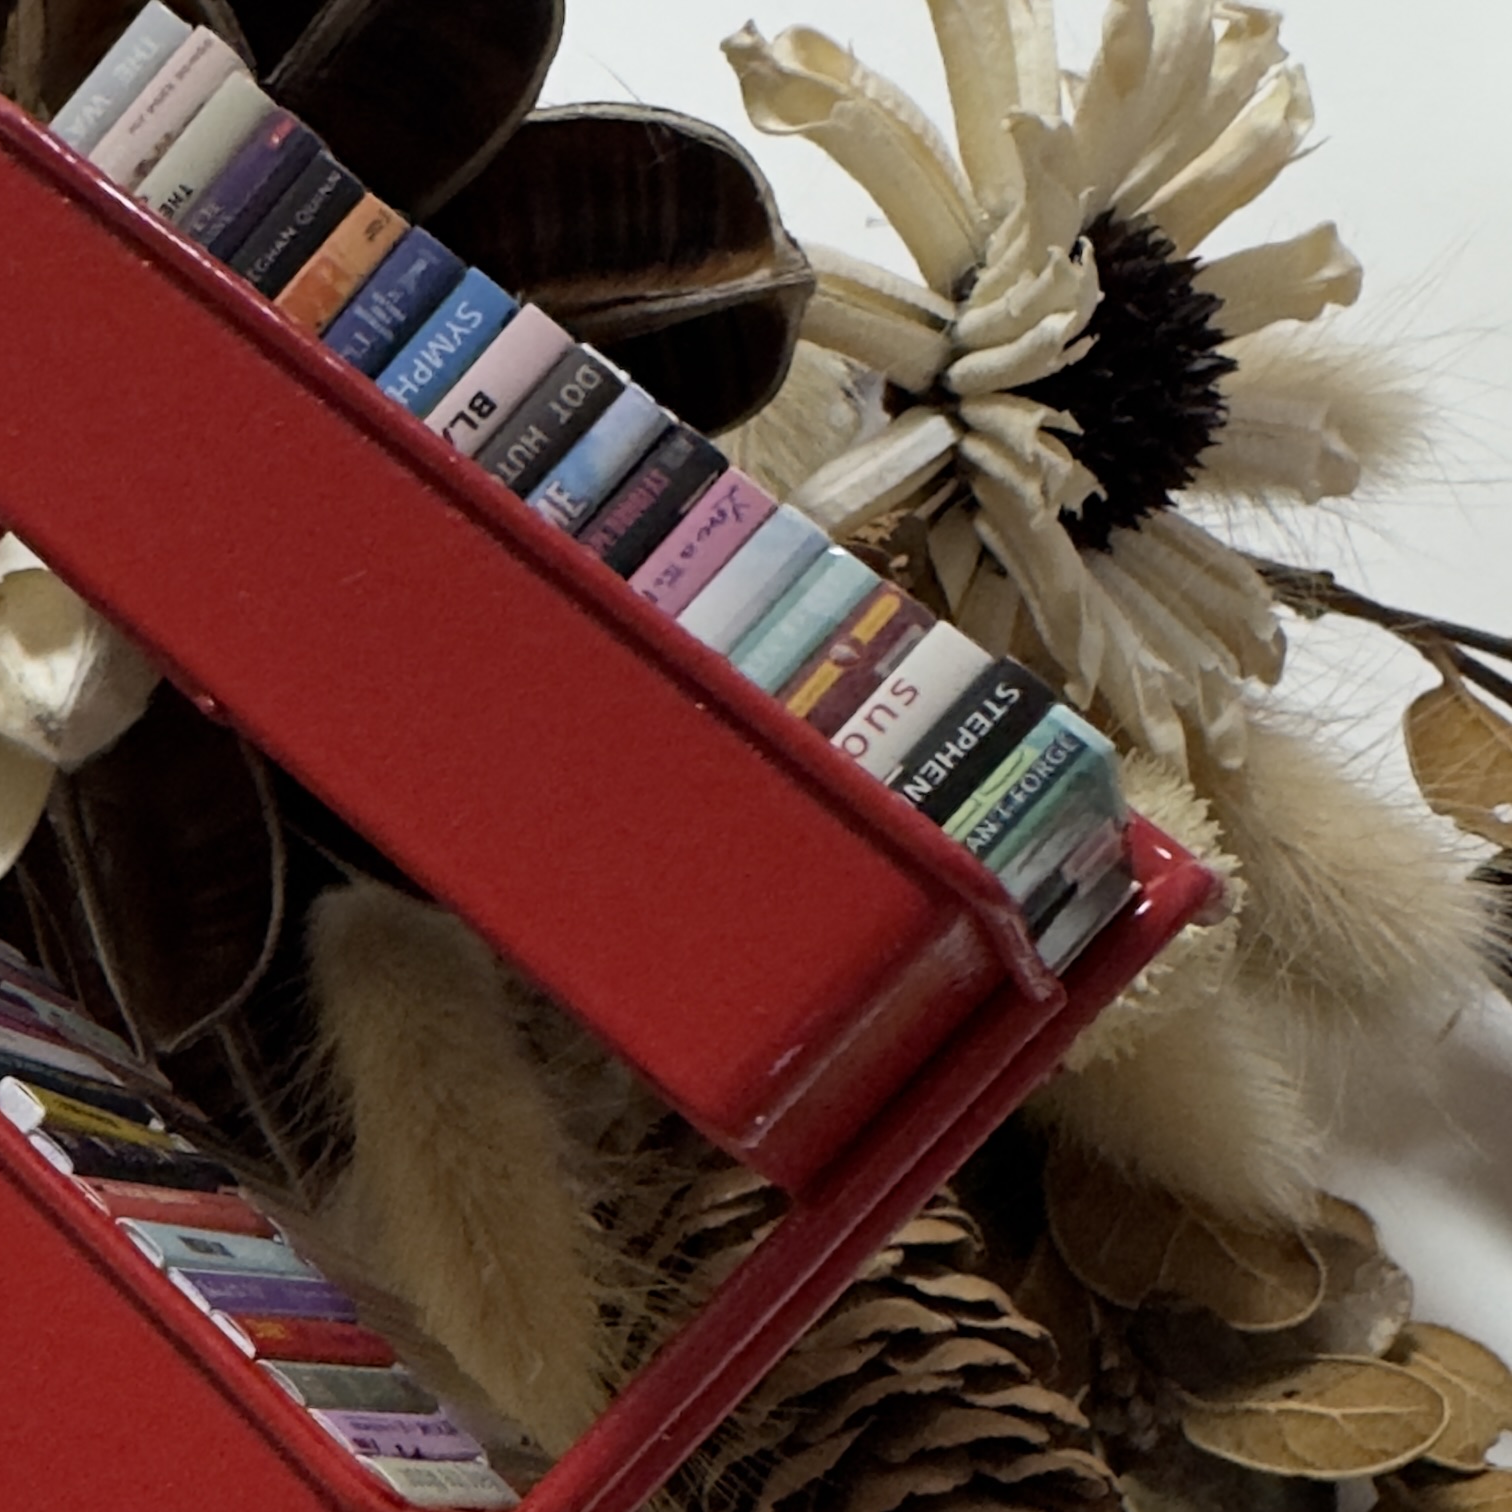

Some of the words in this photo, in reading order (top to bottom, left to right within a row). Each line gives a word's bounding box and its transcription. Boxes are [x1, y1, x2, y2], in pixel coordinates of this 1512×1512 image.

[110, 31, 162, 86] THE
[156, 181, 194, 220] THE
[383, 299, 485, 408] SYMPH
[543, 361, 603, 425] DOT
[488, 423, 550, 490] HUT
